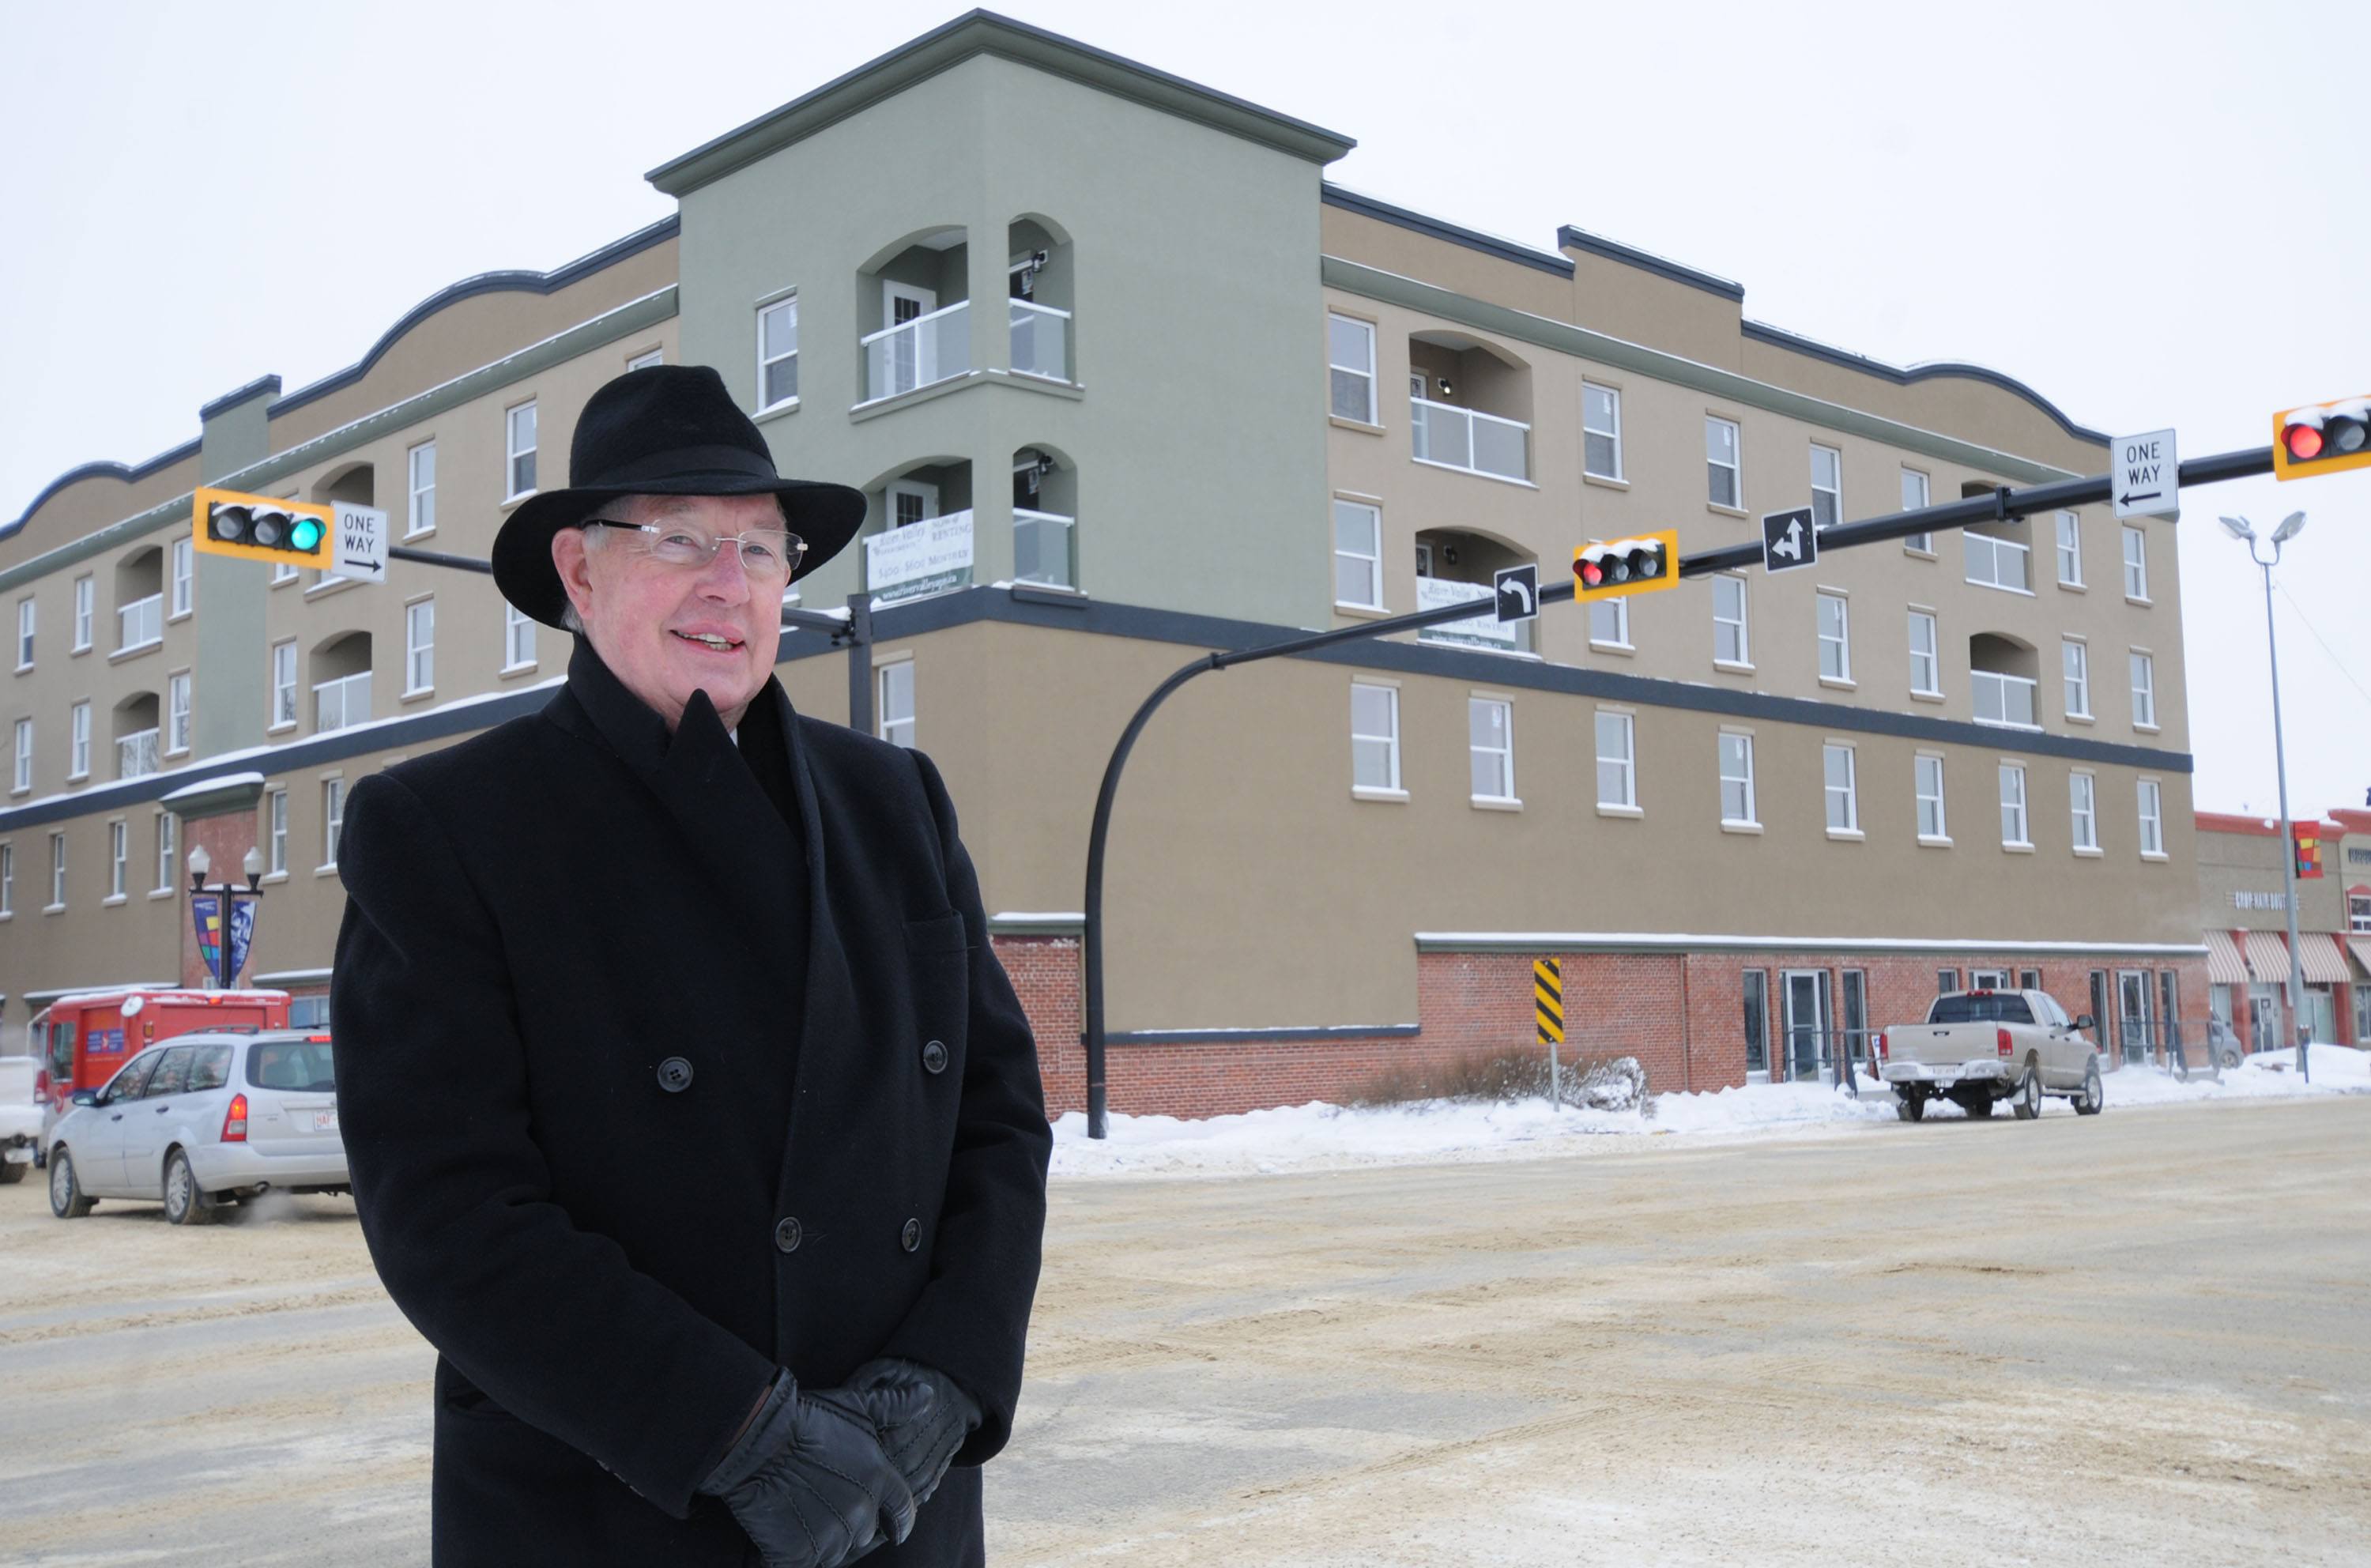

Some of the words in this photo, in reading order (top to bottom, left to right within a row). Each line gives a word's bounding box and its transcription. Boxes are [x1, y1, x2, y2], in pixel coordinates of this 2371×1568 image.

[2126, 441, 2161, 464] ONE
[2128, 464, 2161, 487] WAY
[344, 513, 375, 534] ONE
[933, 525, 972, 541] RENTING
[345, 534, 375, 554] WAY
